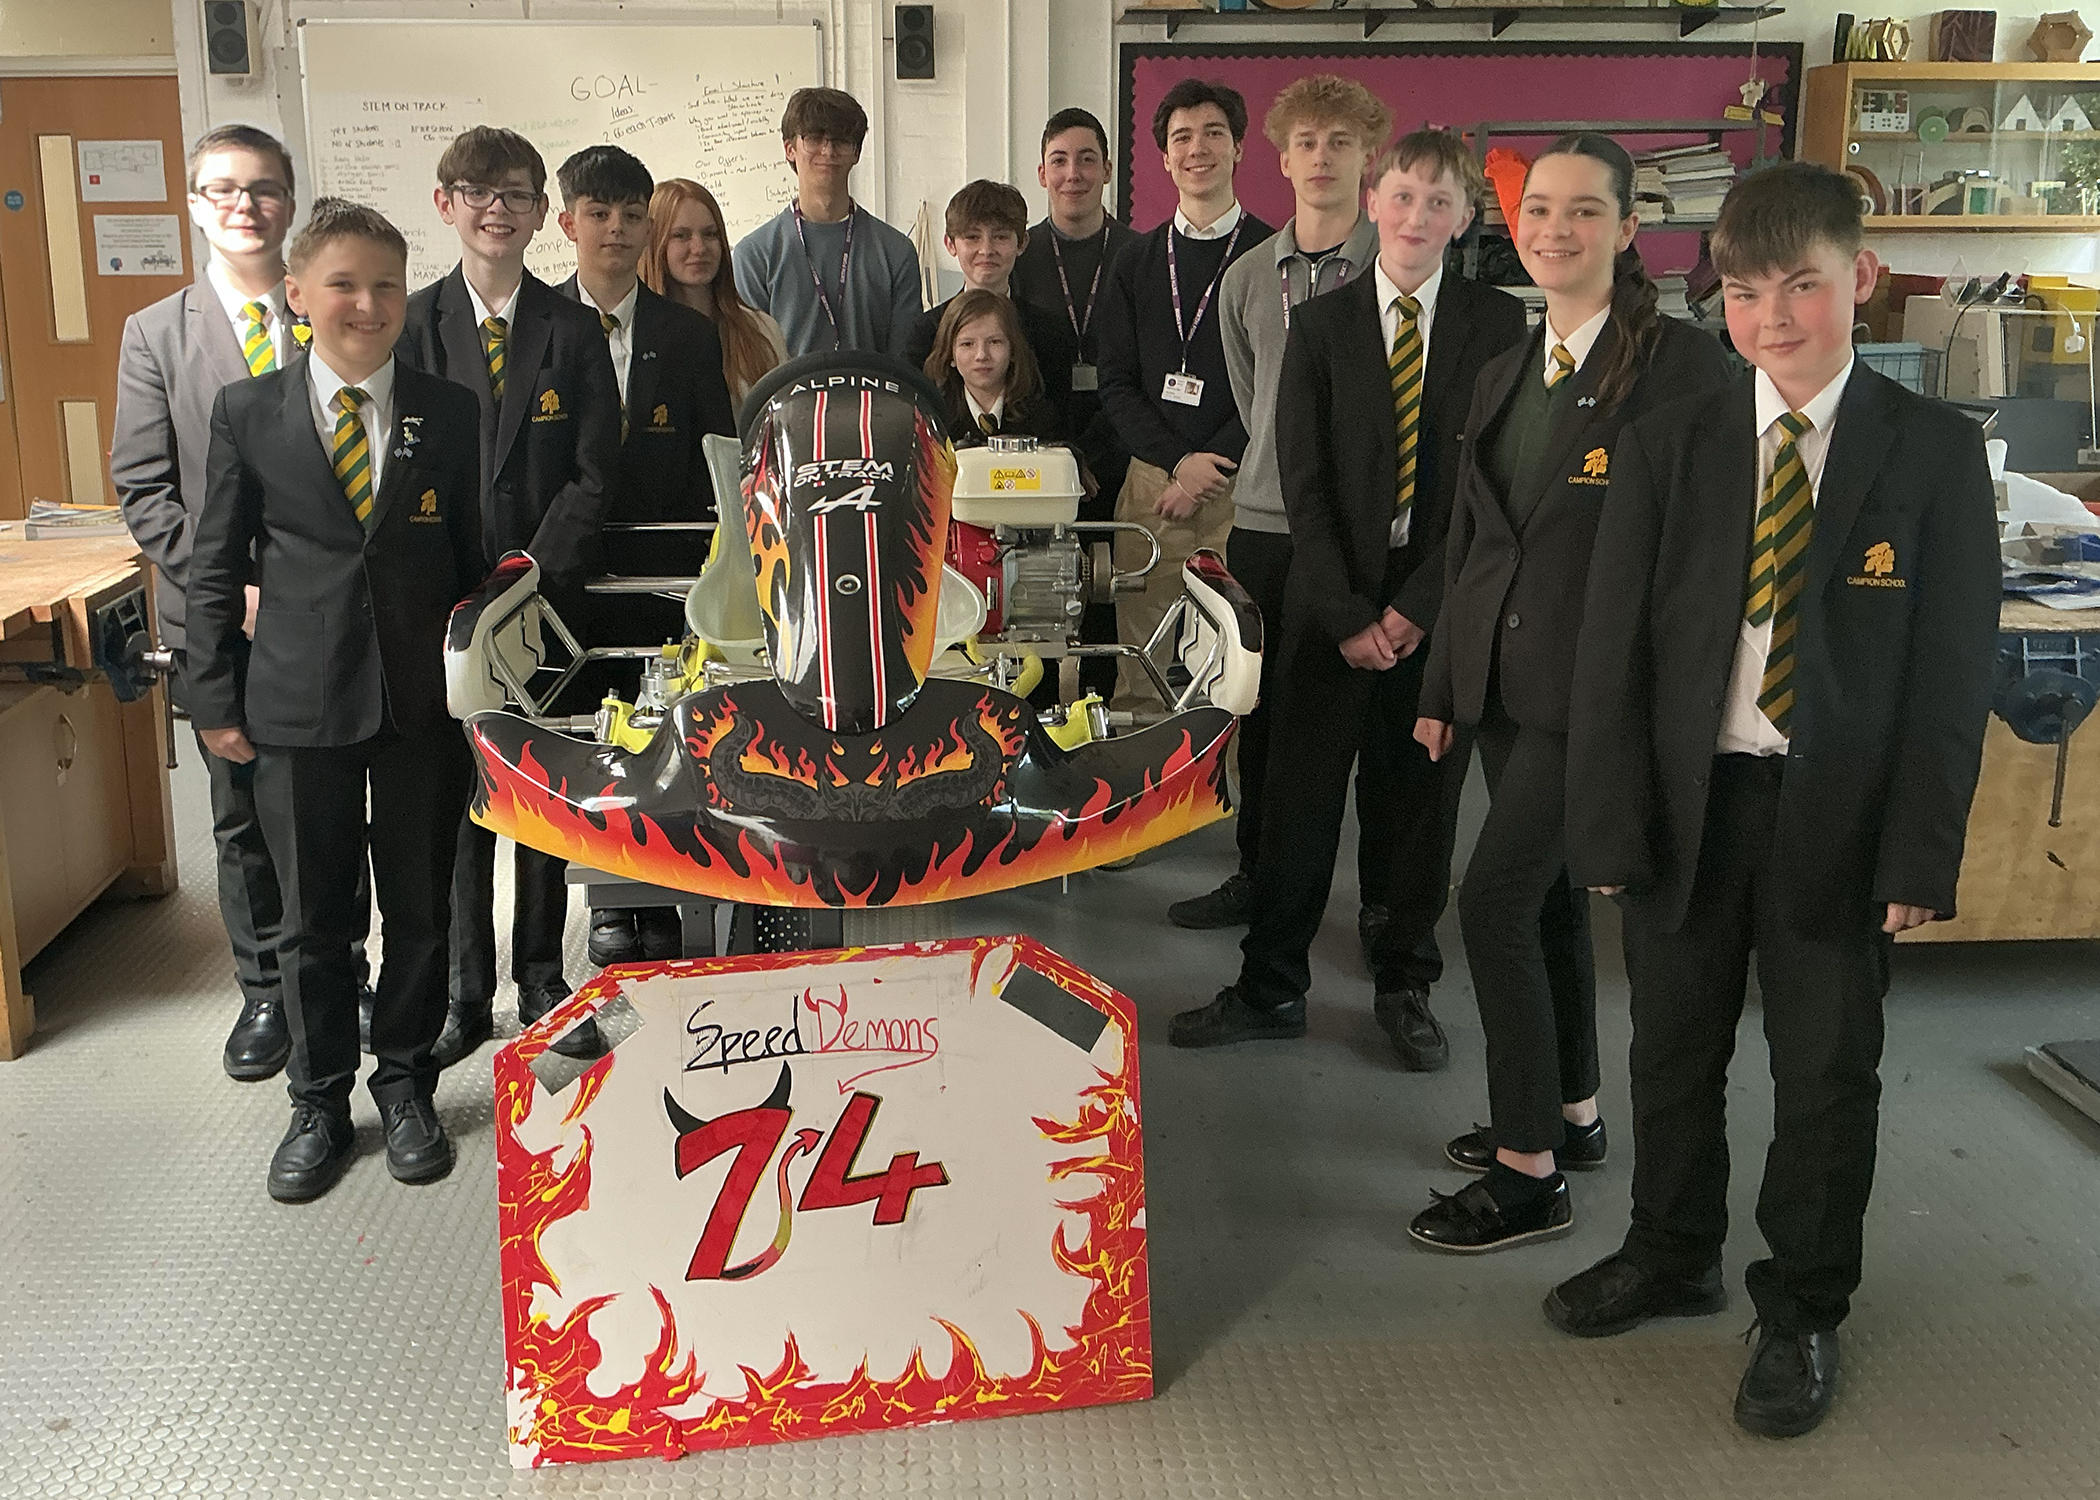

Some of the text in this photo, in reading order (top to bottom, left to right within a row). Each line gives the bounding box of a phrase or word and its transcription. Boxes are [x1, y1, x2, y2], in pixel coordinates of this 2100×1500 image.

[362, 101, 446, 112] STEM ON TRACK
[790, 376, 899, 396] ALPINE
[793, 470, 894, 488] ON TRACK
[796, 460, 894, 481] STEM
[1846, 576, 1906, 588] CAMPION SCHOOL
[684, 991, 939, 1075] Speed Demons
[668, 1089, 951, 1282] 74
